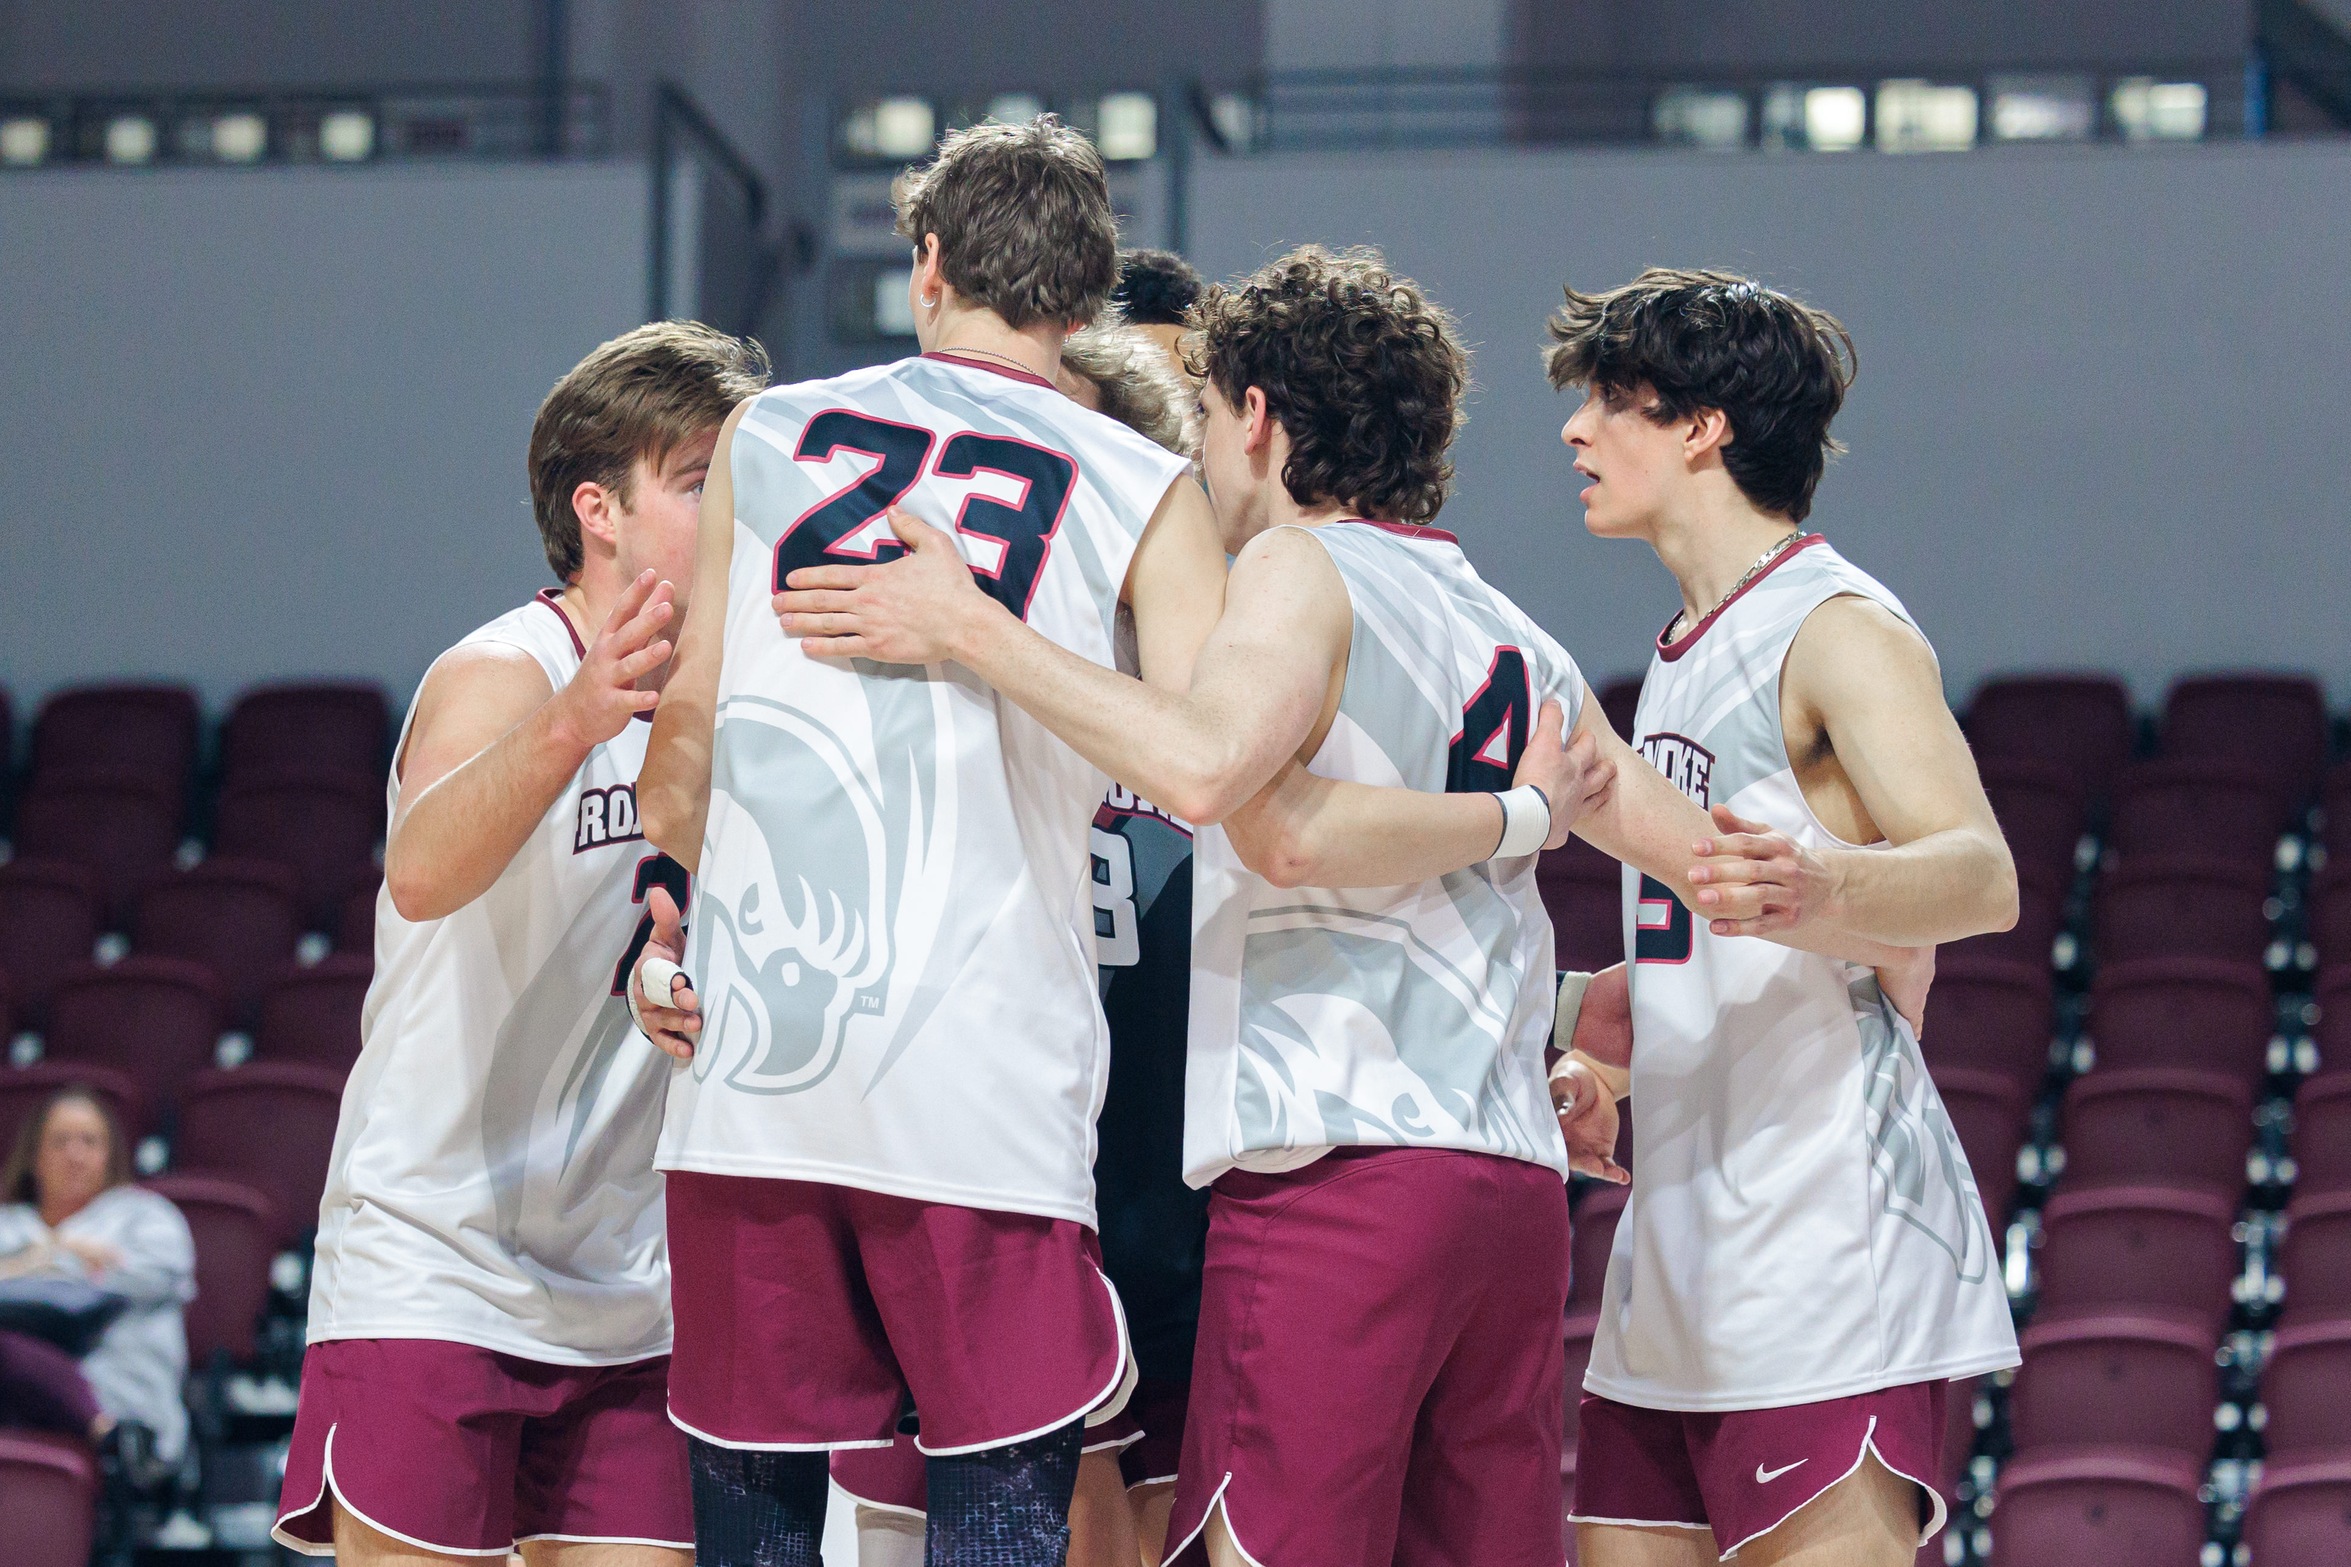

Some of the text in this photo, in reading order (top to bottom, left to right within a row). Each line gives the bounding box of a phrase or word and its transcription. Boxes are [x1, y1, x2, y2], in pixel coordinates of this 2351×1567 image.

[772, 408, 1079, 624] 23
[1445, 645, 1531, 793] 4
[1636, 731, 1715, 812] NOKE
[572, 781, 646, 856] RO
[610, 851, 691, 996] 2
[860, 995, 880, 1009] TM
